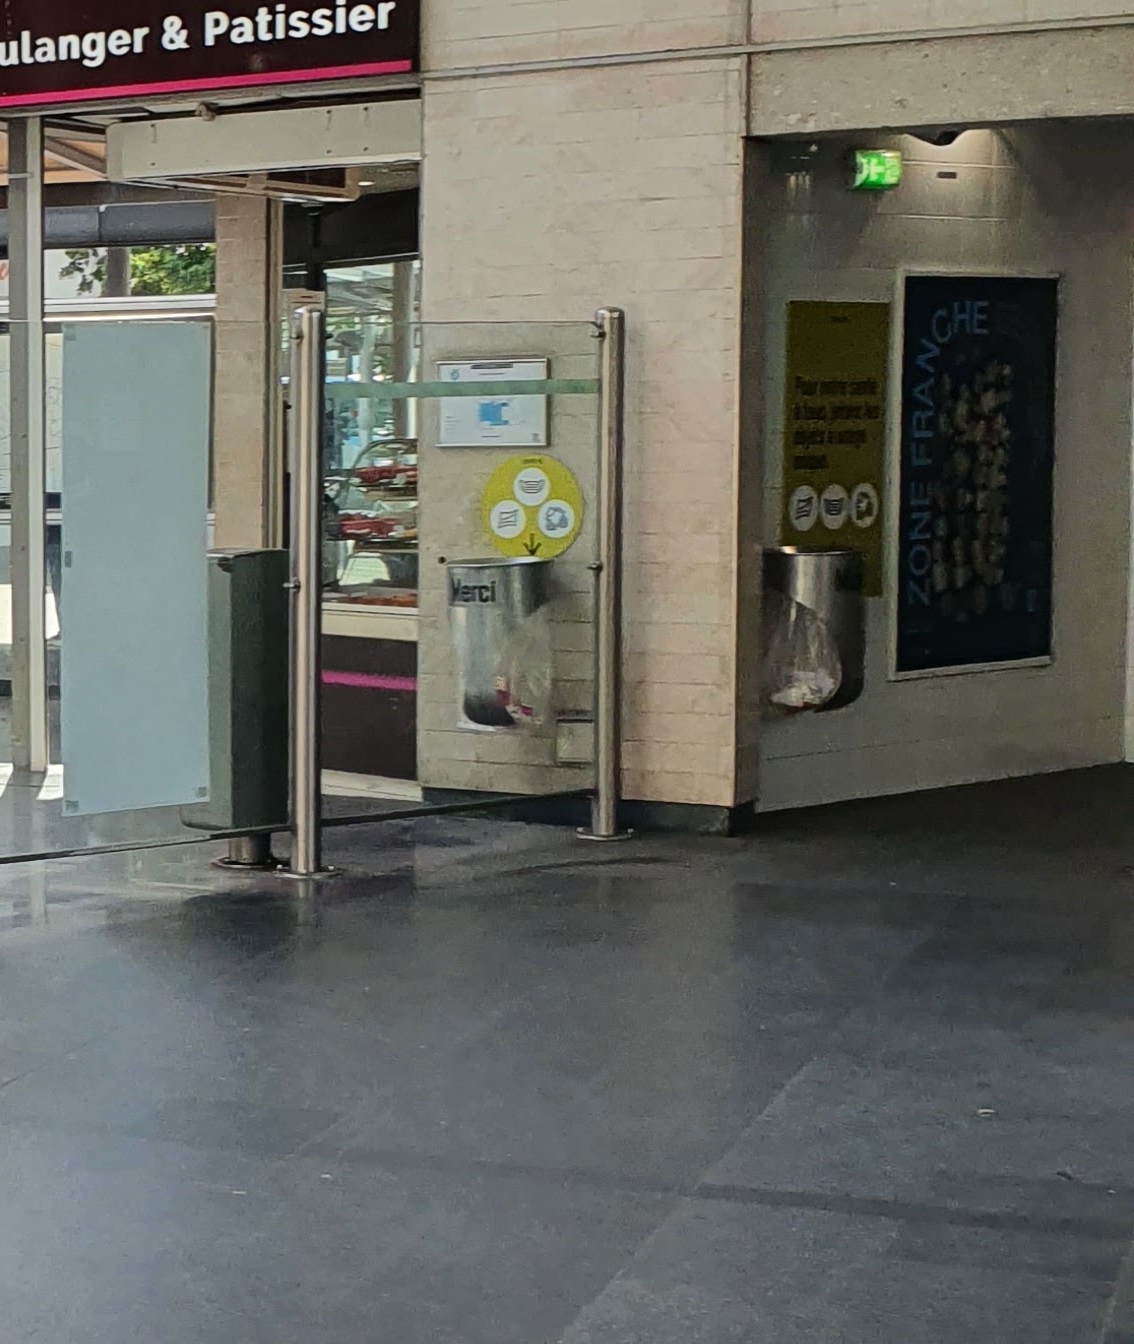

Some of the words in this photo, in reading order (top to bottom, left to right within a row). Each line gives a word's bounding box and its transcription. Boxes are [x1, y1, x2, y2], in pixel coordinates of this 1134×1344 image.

[161, 15, 190, 52] &
[909, 299, 992, 468] FRANCHE
[907, 480, 932, 607] ZONE
